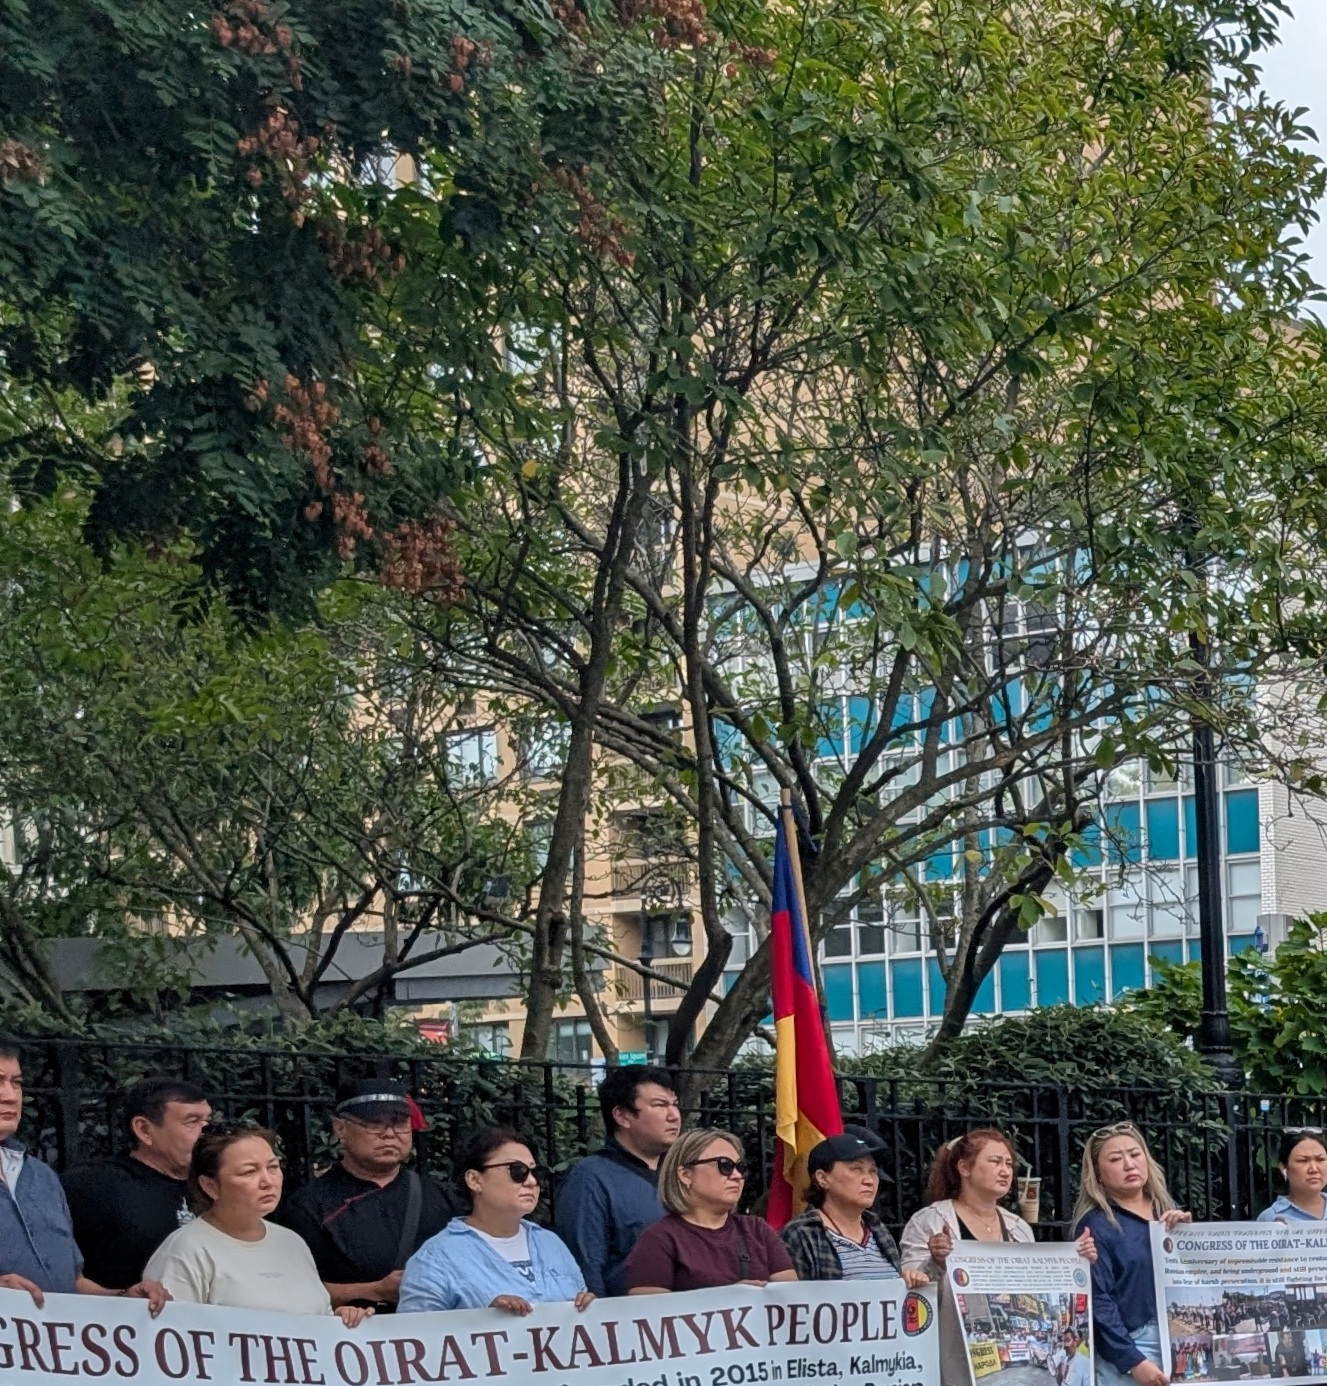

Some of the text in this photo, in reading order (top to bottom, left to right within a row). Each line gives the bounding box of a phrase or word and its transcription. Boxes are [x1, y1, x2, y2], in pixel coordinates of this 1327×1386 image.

[1177, 1239, 1233, 1251] CONGRESS
[1235, 1239, 1248, 1251] OF
[1249, 1239, 1270, 1250] THE
[155, 1328, 215, 1380] OF
[228, 1333, 326, 1385] THE
[334, 1306, 760, 1386] OIRAT-KALMYK
[764, 1300, 897, 1346] PEOPLE
[771, 1360, 782, 1380] in
[787, 1358, 843, 1380] Elista,
[850, 1351, 923, 1377] Kalmykia,
